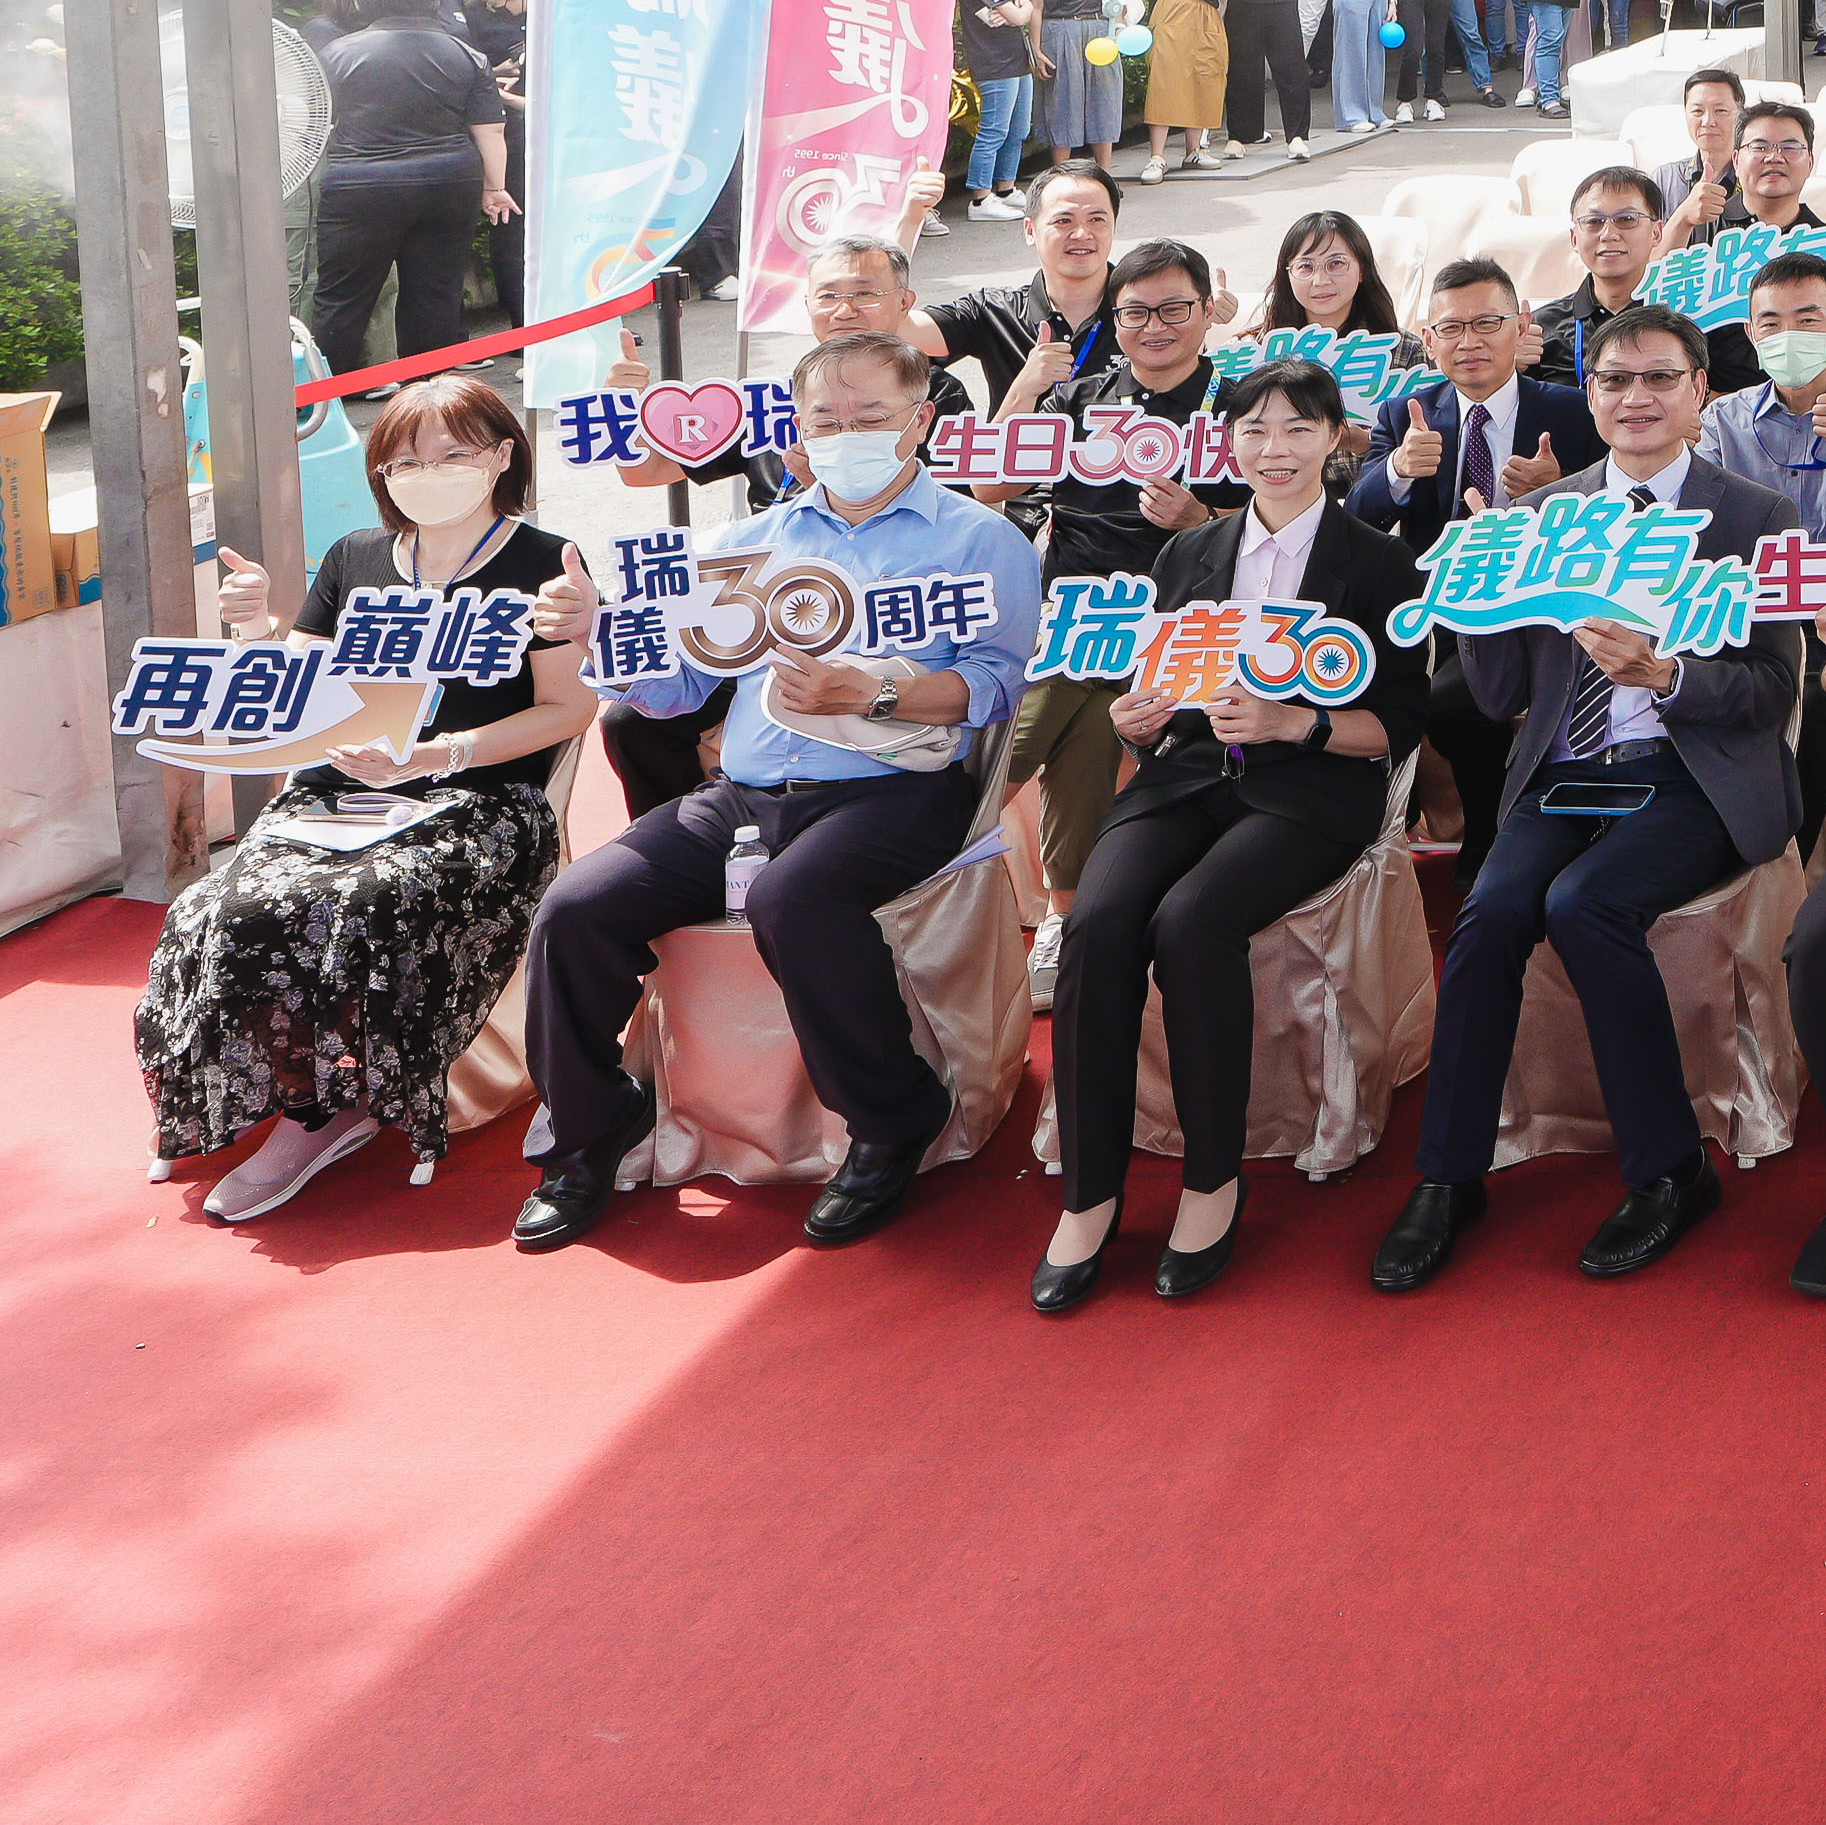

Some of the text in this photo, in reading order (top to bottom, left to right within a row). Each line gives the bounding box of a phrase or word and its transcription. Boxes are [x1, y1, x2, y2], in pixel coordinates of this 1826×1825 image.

[560, 392, 643, 465] 我
[1032, 578, 1370, 704] 瑞儀30
[1396, 497, 1752, 653] 儀路有你
[120, 595, 532, 733] 再創巔峰
